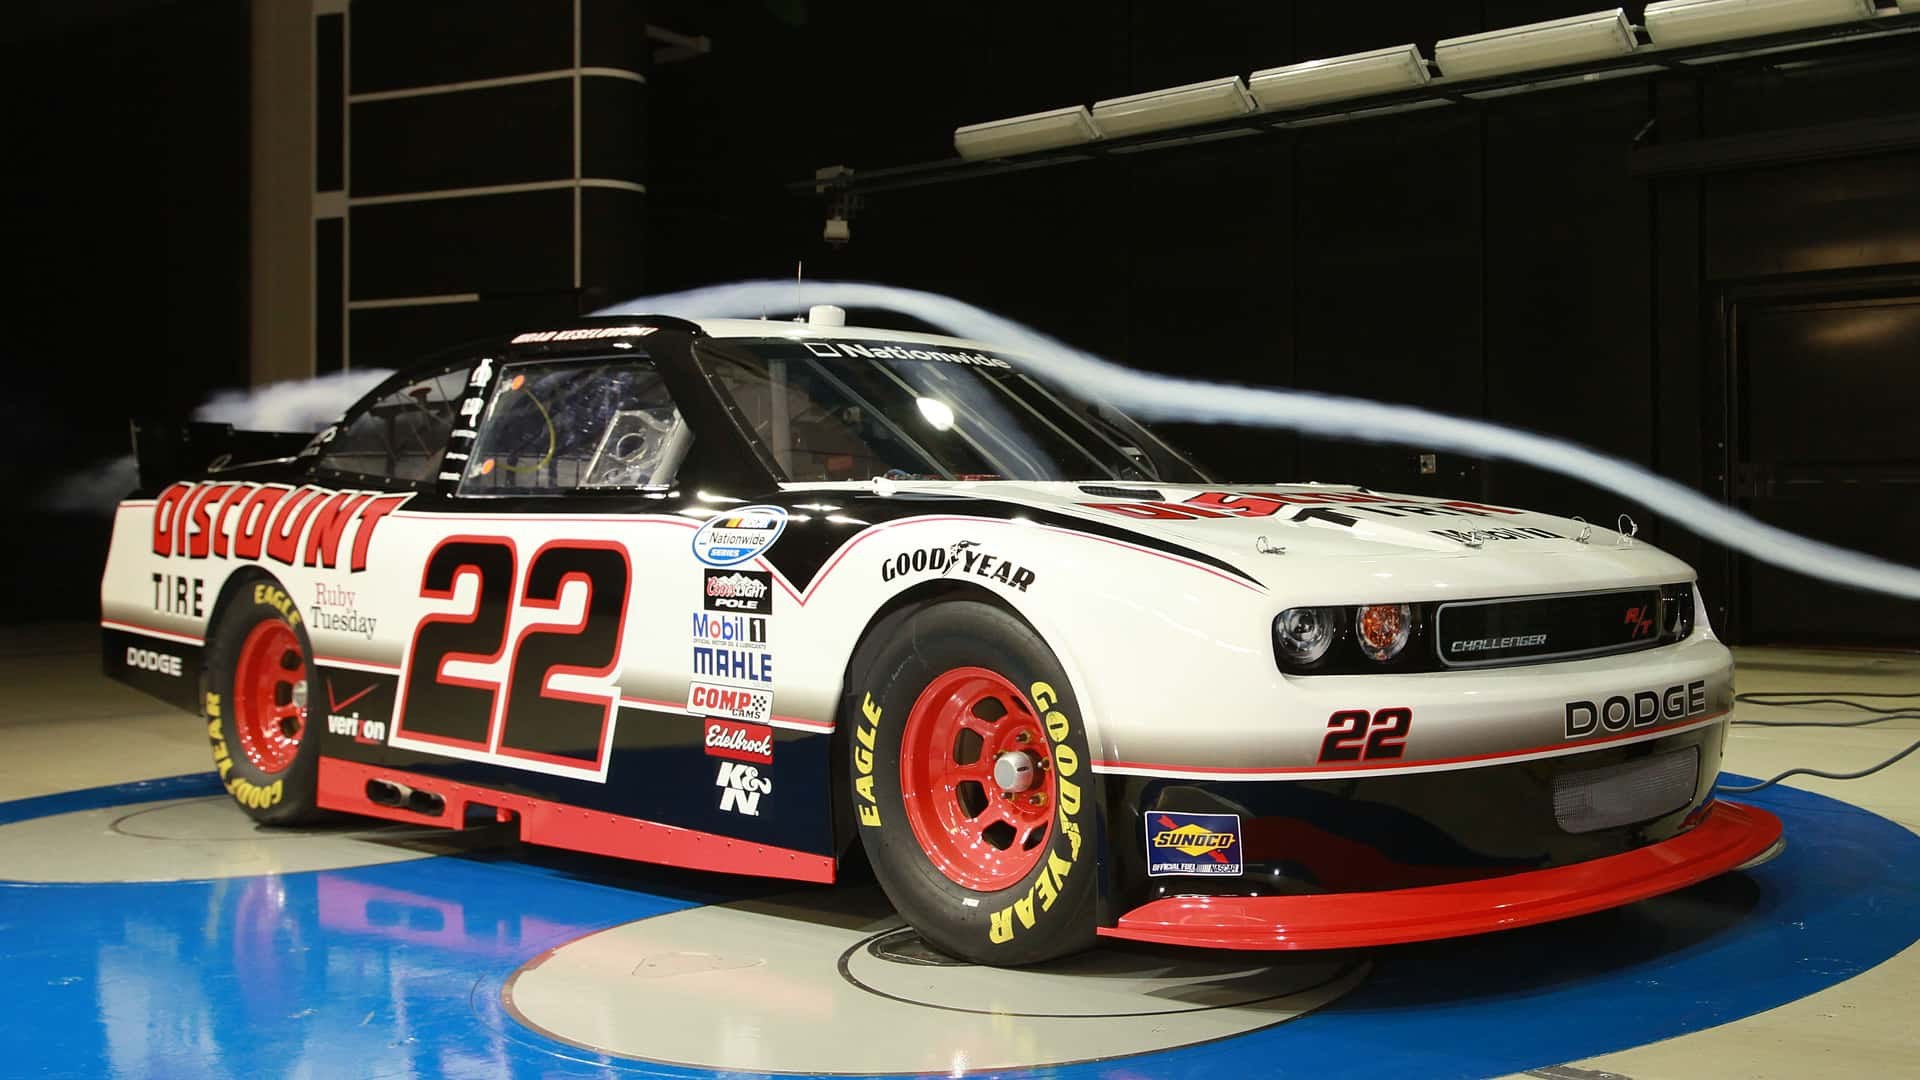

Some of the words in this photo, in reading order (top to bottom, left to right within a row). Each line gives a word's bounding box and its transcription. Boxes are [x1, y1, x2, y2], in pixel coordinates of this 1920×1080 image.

[837, 344, 1011, 369] Nationwide
[153, 482, 413, 573] DISCOUNT
[709, 532, 766, 545] Nationwide
[152, 573, 204, 618] TIRE
[254, 584, 300, 626] EAGLE
[315, 583, 356, 611] Ruby
[715, 599, 758, 609] POLE
[311, 606, 377, 640] Tuesday
[693, 612, 744, 642] Mobil
[751, 618, 764, 642] 1
[397, 534, 632, 772] 22
[1451, 634, 1547, 652] CHALLENGER
[127, 647, 182, 676] DODGE
[694, 646, 772, 682] MAHLE
[693, 686, 752, 711] COMP
[1564, 680, 1705, 739] DODGE
[328, 712, 386, 744] verizon
[732, 709, 761, 720] CAMS
[705, 725, 772, 756] Edelbrock
[1317, 706, 1413, 764] 22
[855, 691, 883, 827] EAGLE
[1157, 833, 1231, 847] SUNOCO
